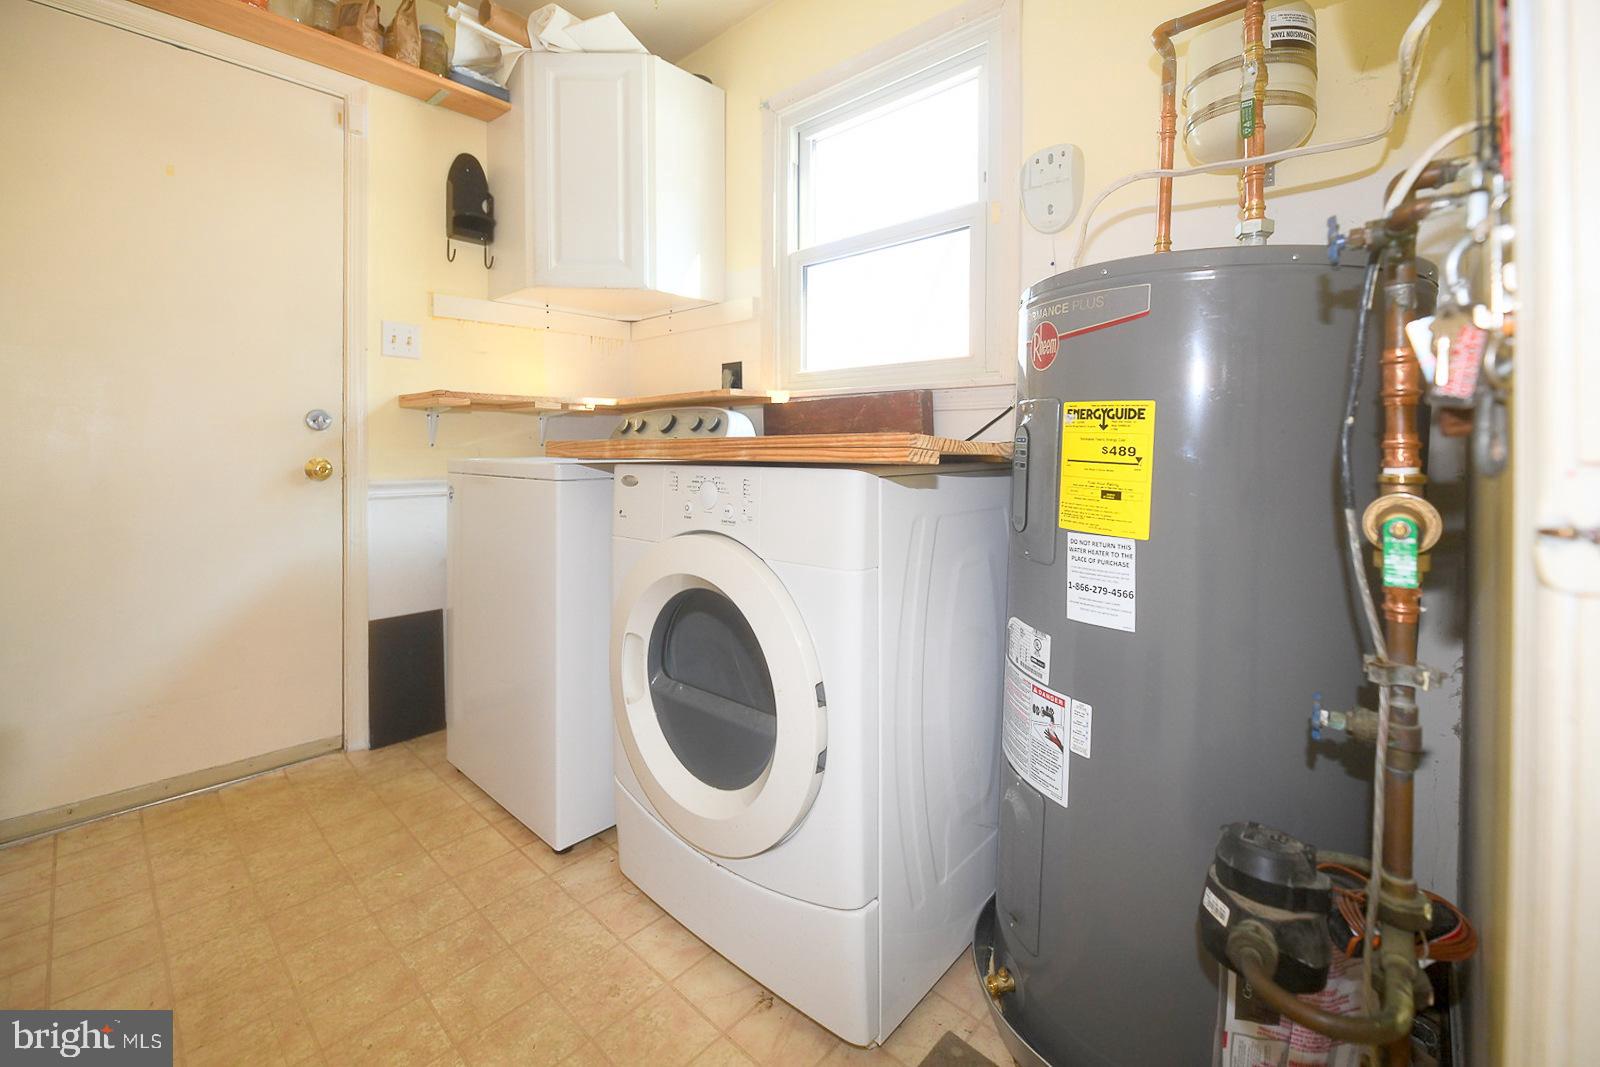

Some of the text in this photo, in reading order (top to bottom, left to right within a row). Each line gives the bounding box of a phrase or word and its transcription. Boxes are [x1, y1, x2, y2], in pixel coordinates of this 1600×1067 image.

[1072, 295, 1105, 311] PLUS
[1033, 322, 1056, 362] Rheem
[1092, 541, 1116, 549] RETURN
[1088, 549, 1109, 557] HEATER
[1098, 558, 1130, 568] PURCHASE
[1038, 689, 1064, 706] DANGER
